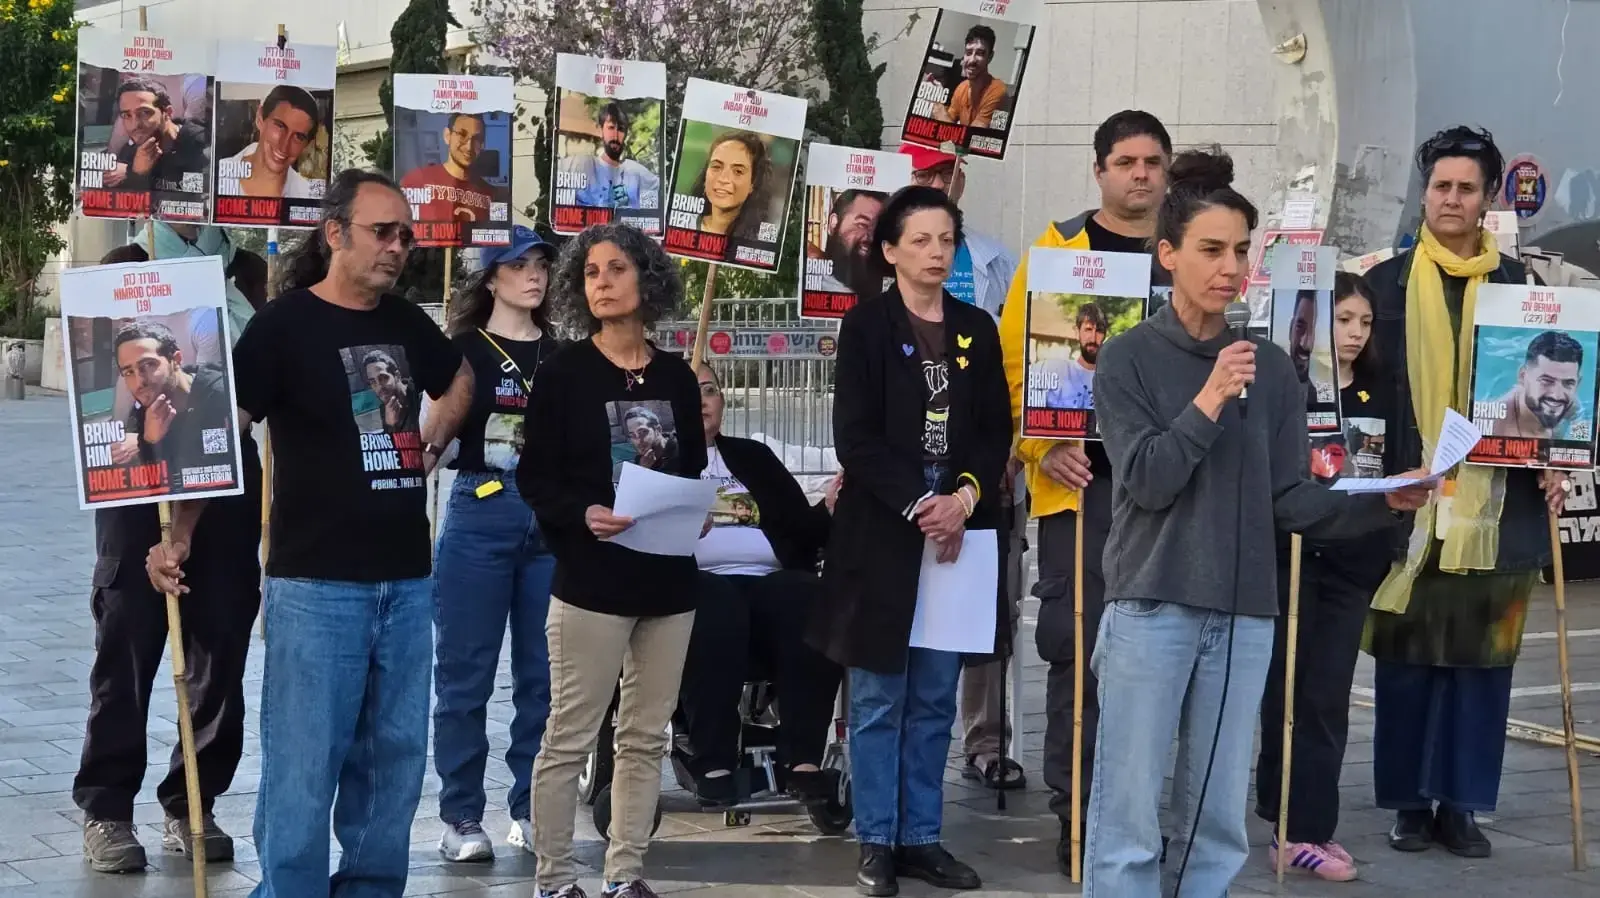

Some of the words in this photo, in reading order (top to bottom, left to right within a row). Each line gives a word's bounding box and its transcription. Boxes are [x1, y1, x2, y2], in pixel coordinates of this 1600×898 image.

[123, 47, 150, 59] NIMROD
[151, 49, 172, 60] COHEN
[258, 56, 281, 68] HADAR
[122, 59, 138, 70] 20
[594, 73, 607, 85] GUY
[433, 89, 453, 100] TAMIR
[919, 82, 949, 104] BRING
[723, 100, 743, 113] INBAR
[912, 98, 934, 118] HIM
[738, 113, 752, 126] (27)
[907, 118, 936, 138] HOME
[938, 124, 966, 144] NOW!
[81, 151, 118, 171] BRING
[219, 160, 252, 178] BRING
[845, 163, 862, 175] EITAN
[80, 170, 104, 189] HIM
[218, 178, 240, 196] HIM
[556, 171, 588, 190] BRING
[82, 190, 114, 209] HOME
[115, 192, 151, 211] NOW!
[555, 188, 577, 206] HIM
[671, 193, 706, 215] BRING
[217, 198, 249, 216] HOME
[555, 207, 585, 225] HOME
[668, 210, 691, 230] HER
[666, 229, 696, 248] HOME
[806, 258, 834, 276] BRING
[1072, 267, 1085, 278] GUY
[114, 286, 144, 301] NIMROD
[145, 284, 172, 298] COHEN
[804, 275, 823, 292] HIM
[136, 300, 152, 313] (19)
[803, 293, 831, 310] HOME
[1521, 301, 1533, 312] ZIV
[1532, 303, 1561, 313] BERMAN
[1523, 313, 1543, 323] (27)
[1028, 371, 1059, 391] BRING
[1027, 389, 1048, 408] HIM
[1026, 410, 1056, 428] HOME
[1473, 401, 1508, 420] BRING
[83, 420, 126, 445] BRING
[360, 433, 394, 451] BRING
[1504, 439, 1539, 458] NOW!
[86, 444, 113, 467] HIM
[362, 450, 402, 472] HOME
[88, 466, 128, 492] HOME
[129, 460, 169, 488] NOW!
